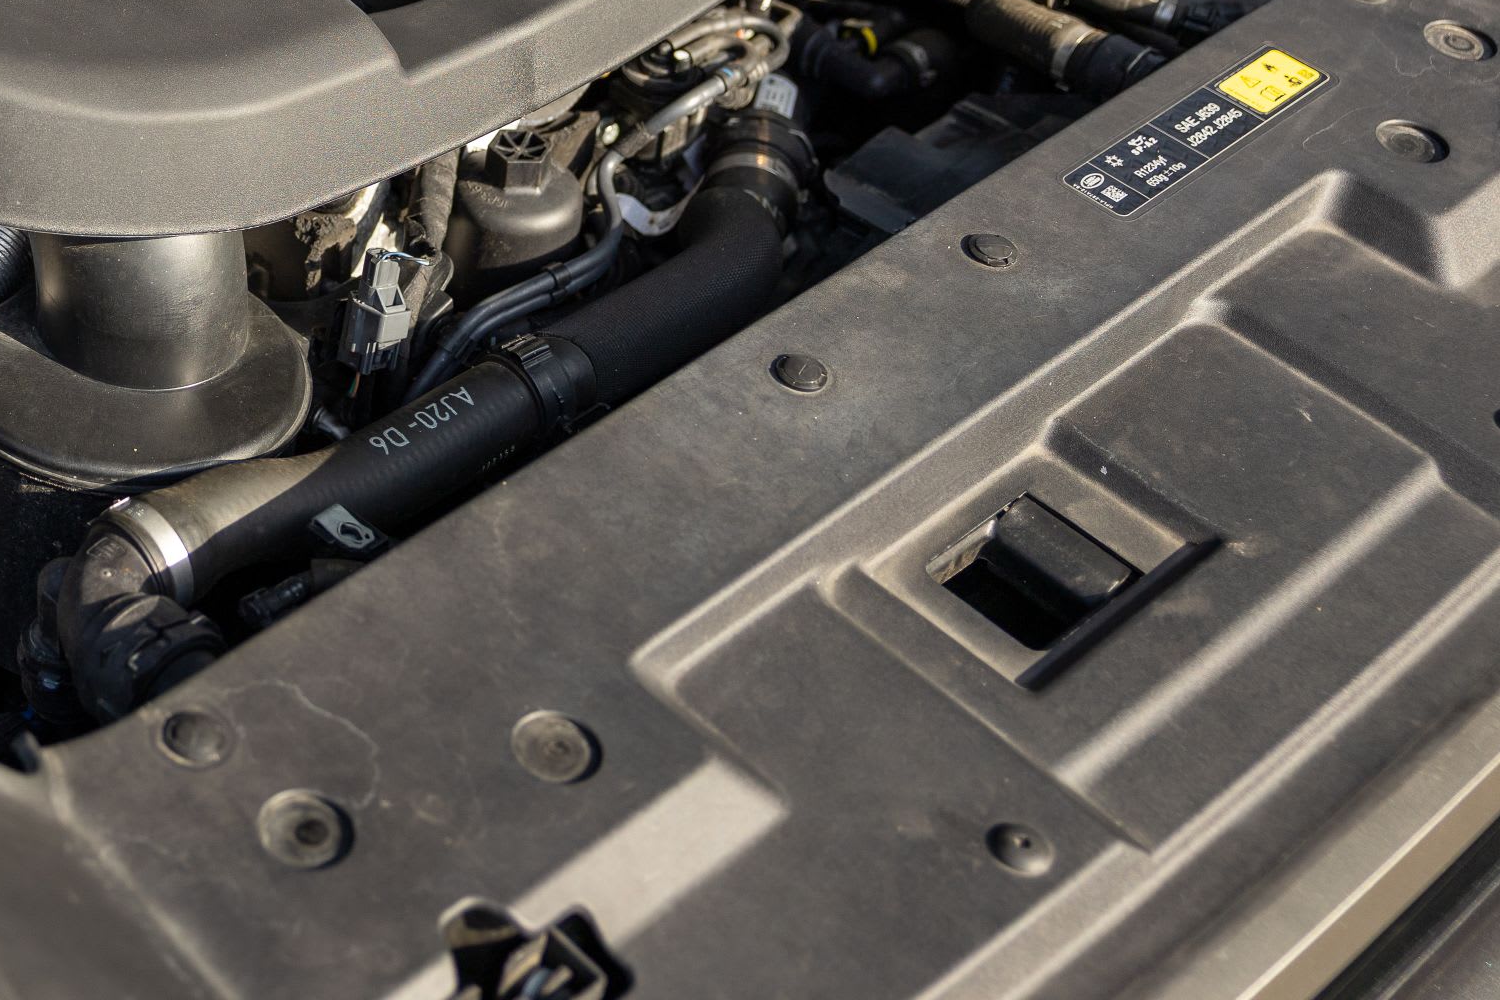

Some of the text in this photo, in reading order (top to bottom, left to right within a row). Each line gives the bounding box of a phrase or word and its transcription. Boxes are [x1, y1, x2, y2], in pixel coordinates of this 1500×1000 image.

[1174, 102, 1220, 133] SAE J639
[1186, 107, 1243, 147] J2842 J2845
